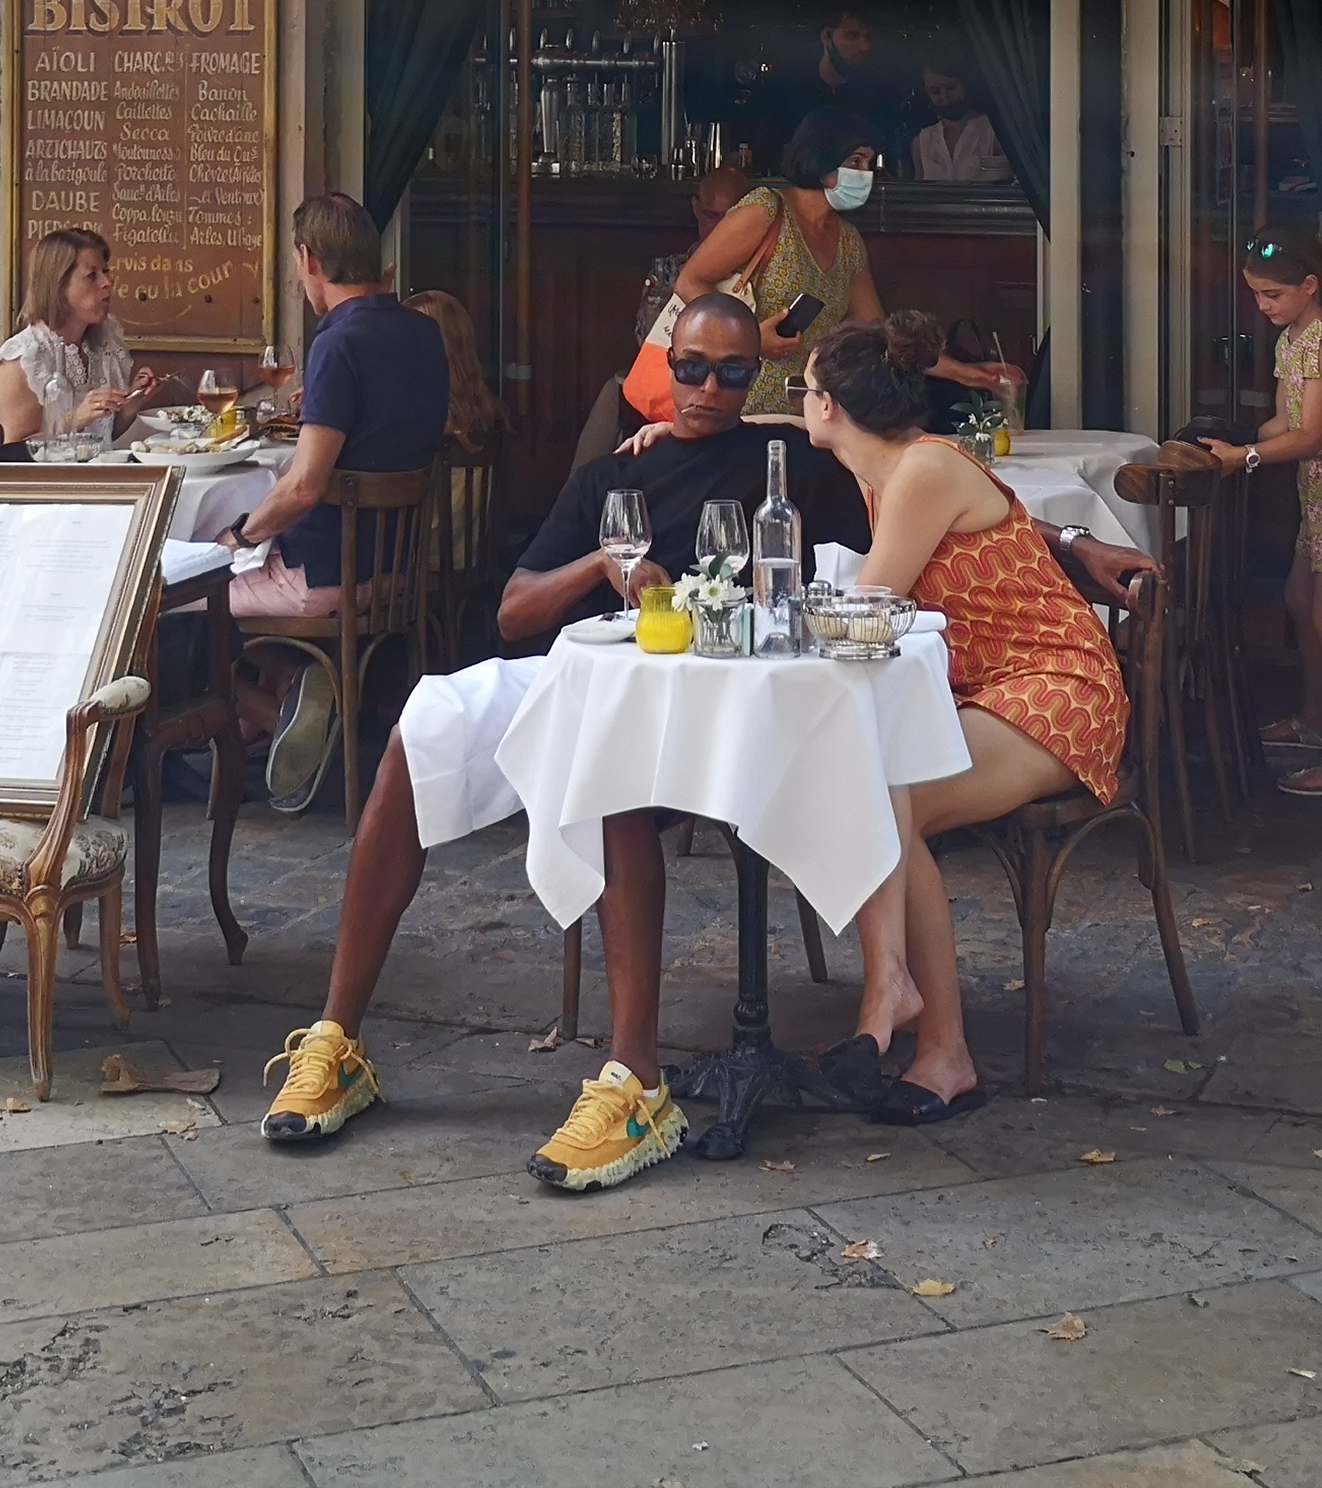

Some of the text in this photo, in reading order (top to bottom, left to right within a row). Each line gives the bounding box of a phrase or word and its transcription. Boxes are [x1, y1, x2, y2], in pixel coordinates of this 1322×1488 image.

[35, 47, 96, 73] AÏOLI
[190, 52, 262, 74] FROMAGE
[27, 80, 108, 102] BRANDADE
[27, 109, 105, 133] LIMAÇOUN
[116, 101, 173, 120] Caillettes
[25, 138, 108, 160] ARTICHAUTS
[190, 142, 215, 162] Bleu
[217, 145, 231, 162] du
[32, 191, 100, 212] DAUBE
[187, 260, 233, 295] cour
